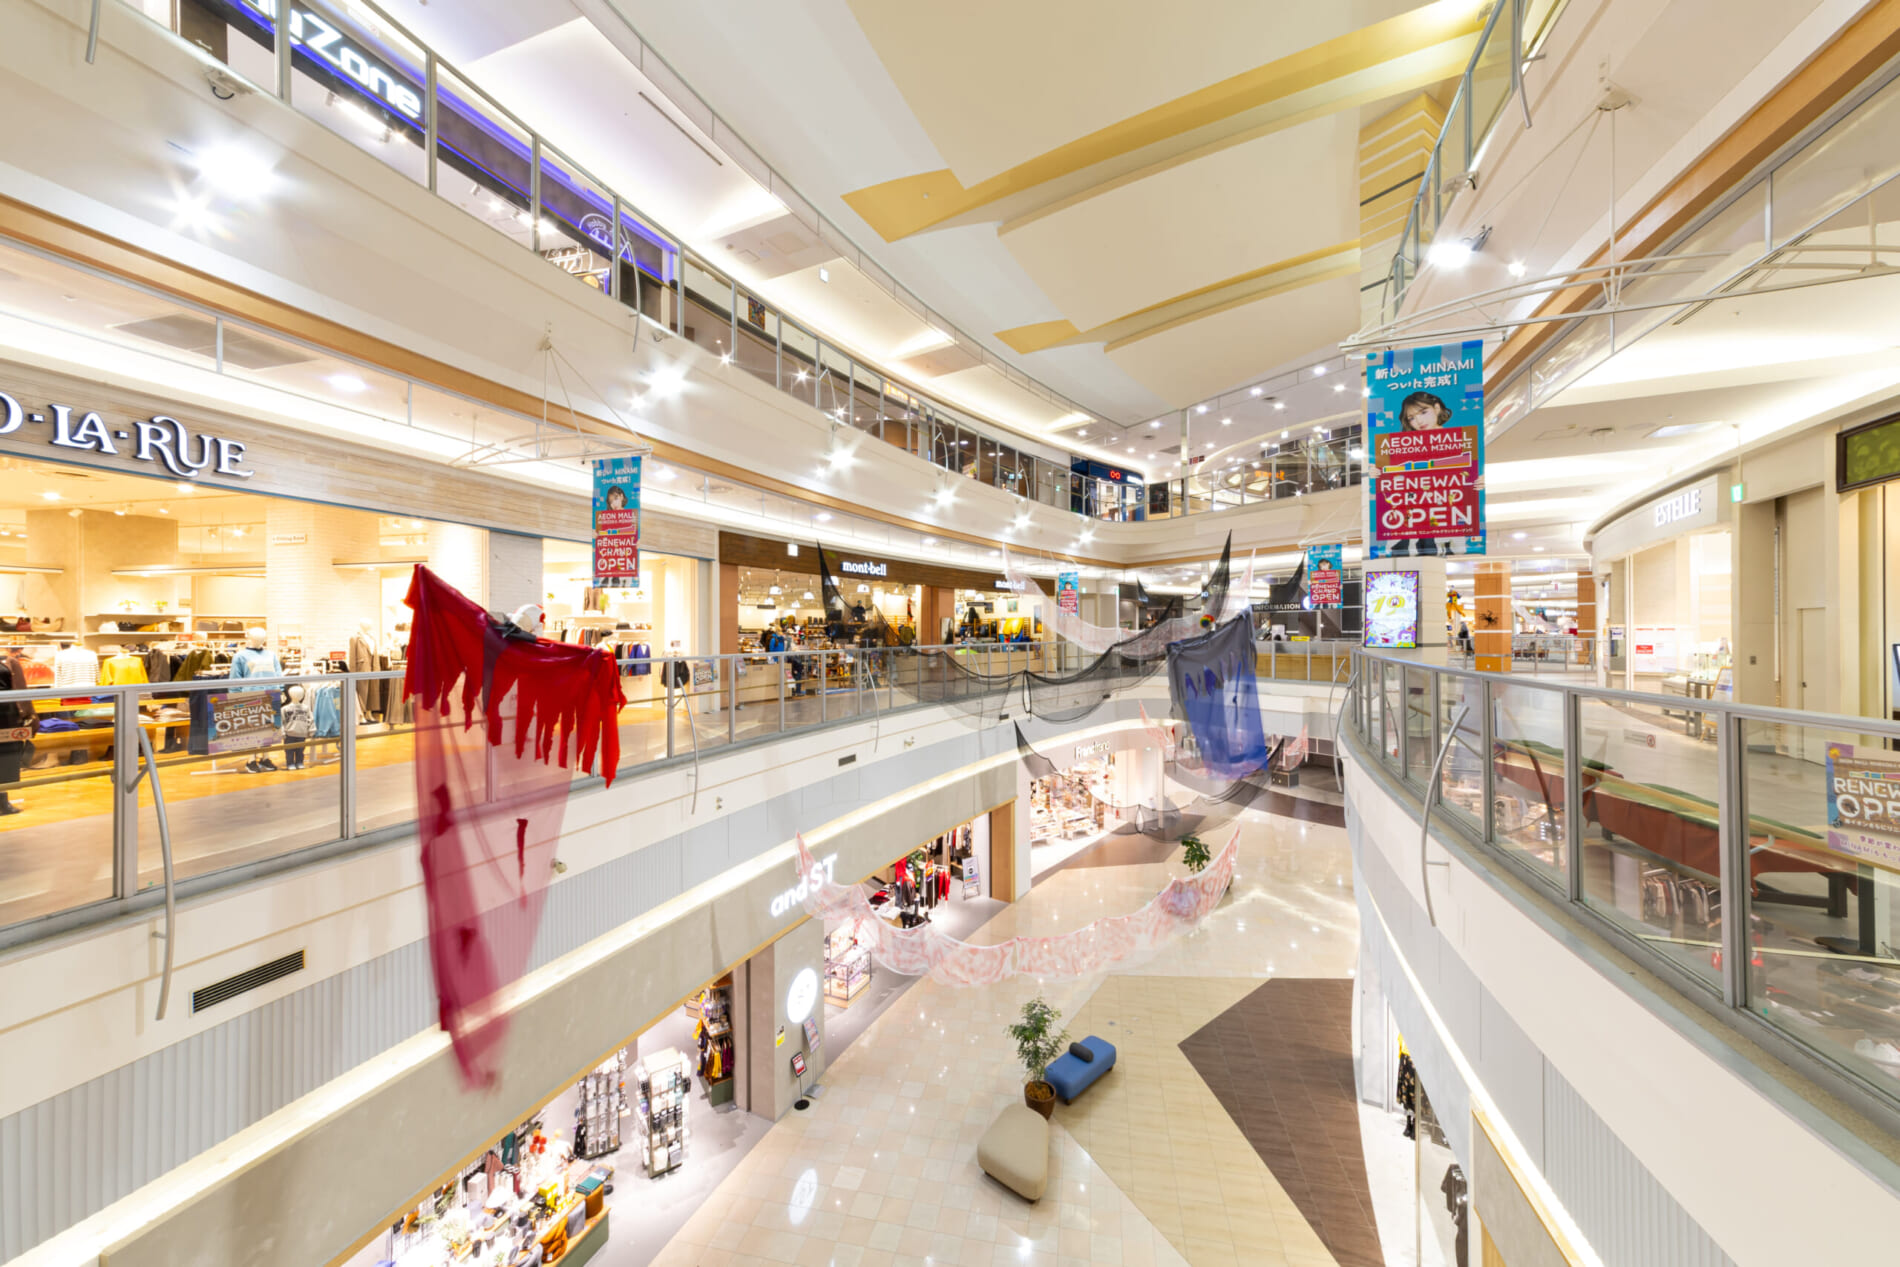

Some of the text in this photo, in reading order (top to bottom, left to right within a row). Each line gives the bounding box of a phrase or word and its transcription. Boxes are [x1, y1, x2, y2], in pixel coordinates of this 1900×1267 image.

[1375, 358, 1475, 380] 新しい MINAMI
[1386, 373, 1458, 391] ついに完成!
[1380, 431, 1473, 449] AEON MALL
[1380, 441, 1473, 456] MORIOKA MINAMI
[1380, 474, 1473, 492] RENEWAL
[1388, 489, 1464, 506] GRAND
[598, 511, 636, 521] AEON MALL
[1382, 505, 1473, 529] OPEN
[1655, 489, 1702, 528] ESTELLE
[597, 538, 637, 547] RENEWAL
[600, 548, 633, 557] GRAND
[597, 557, 636, 571] OPEN
[1311, 593, 1340, 601] OPEN
[213, 703, 273, 721] RENEWAL
[215, 713, 275, 733] OPEN
